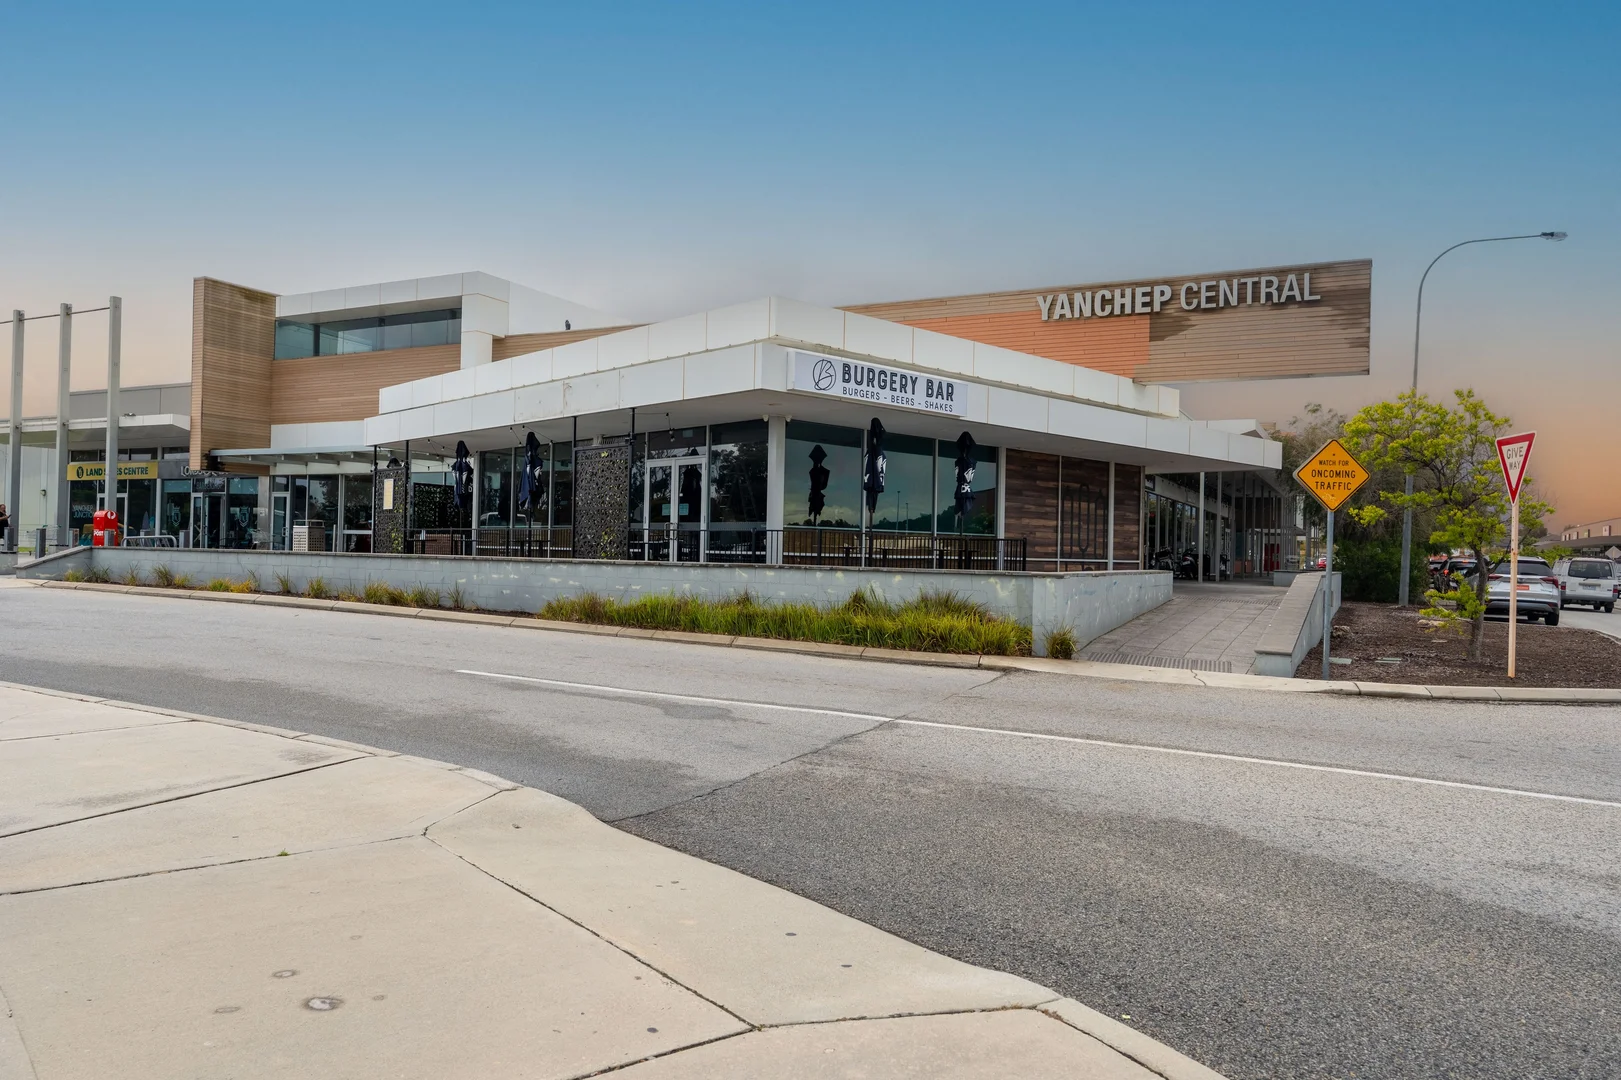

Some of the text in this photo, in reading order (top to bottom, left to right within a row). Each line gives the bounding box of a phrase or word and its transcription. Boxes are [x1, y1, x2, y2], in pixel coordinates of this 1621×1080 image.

[1036, 272, 1321, 321] YANCHEP CENTRAL
[842, 363, 954, 402] BURGERY BAR
[843, 386, 880, 401] BURGERS
[891, 394, 914, 407] BEERS
[925, 400, 953, 413] SHAKES
[1506, 446, 1524, 459] GIVE
[1509, 460, 1521, 470] WAY
[86, 468, 103, 477] LAND
[104, 467, 122, 476] SES
[123, 466, 149, 476] CENTRE
[1311, 469, 1356, 479] ONCOMING
[1315, 481, 1352, 491] TRAFFIC
[73, 511, 93, 519] JUNCTIO
